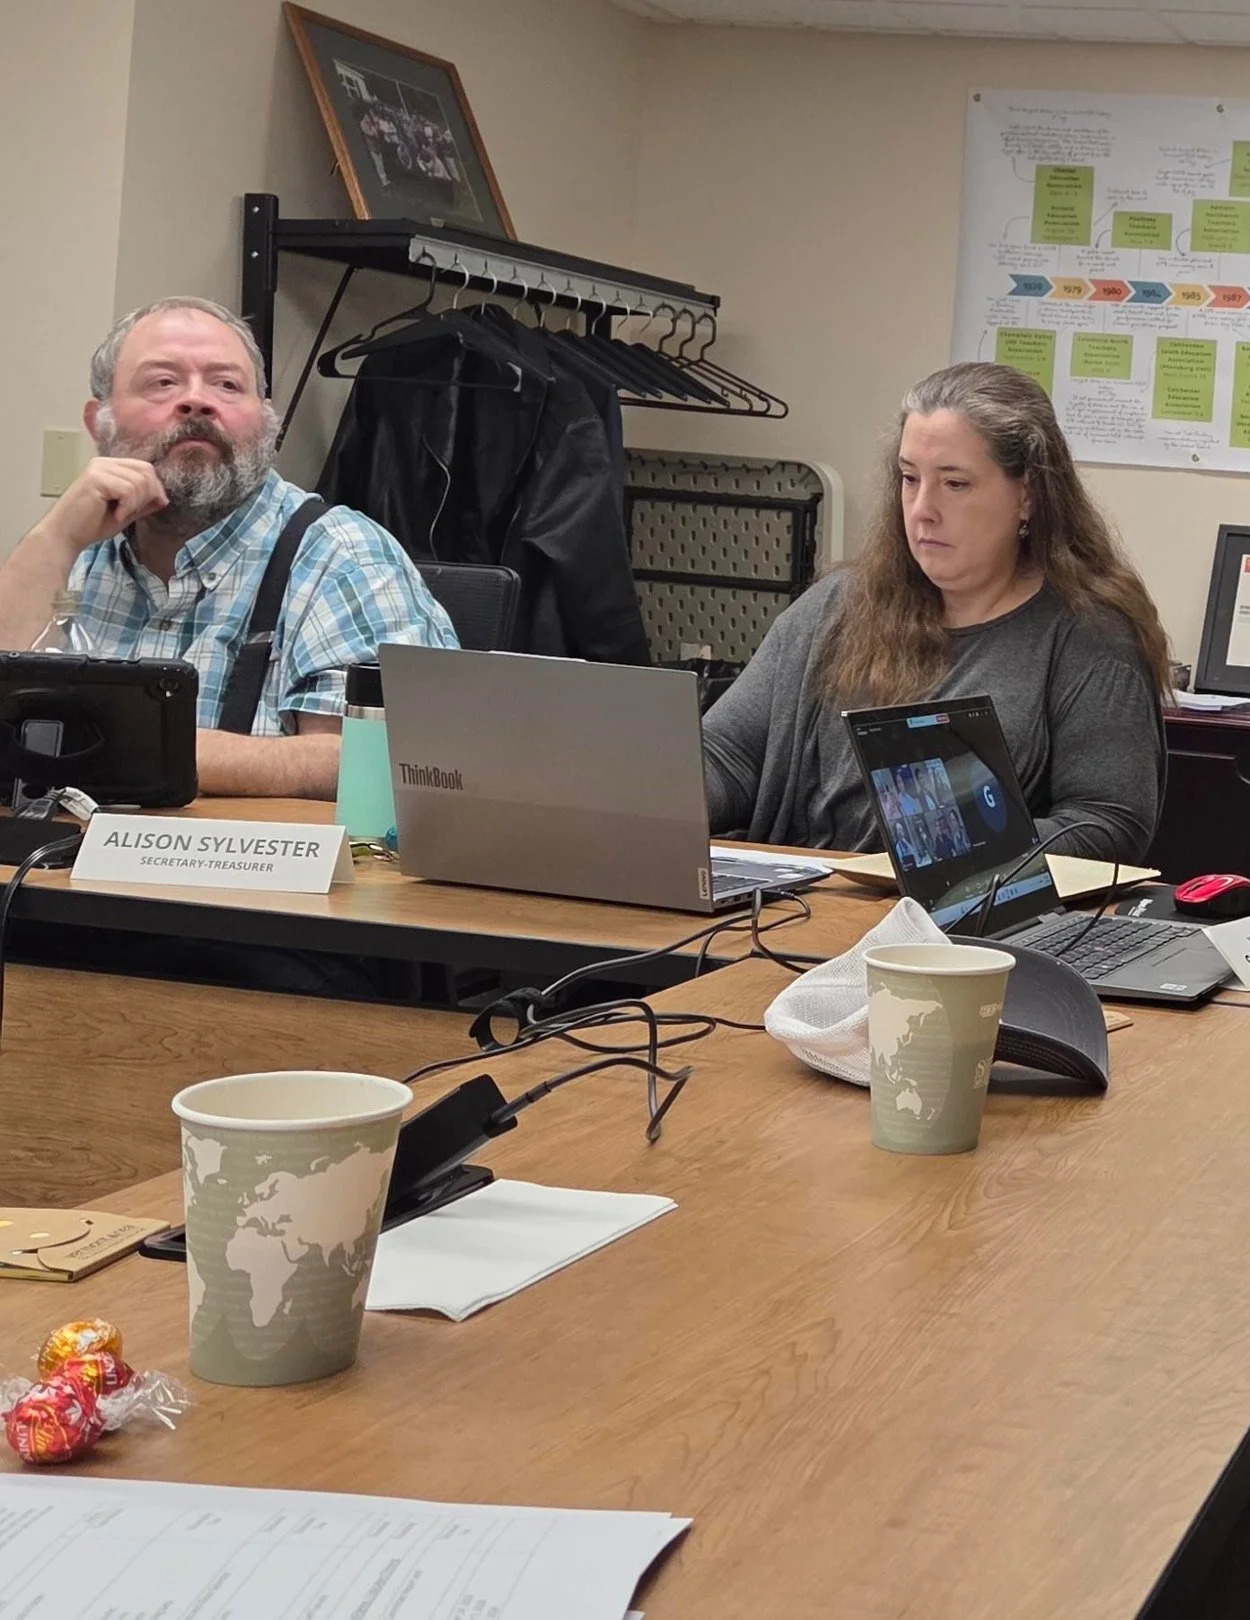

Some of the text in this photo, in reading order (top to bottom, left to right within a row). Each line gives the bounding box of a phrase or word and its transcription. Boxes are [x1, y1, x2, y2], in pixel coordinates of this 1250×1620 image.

[1063, 284, 1083, 295] 1979
[1102, 286, 1122, 297] 1980
[1181, 291, 1202, 301] 1985
[1222, 293, 1243, 303] 1987
[398, 762, 464, 791] ThinkBook
[982, 784, 997, 809] G
[103, 830, 321, 858] ALISON SYLVESTER
[139, 855, 275, 873] SECRETARY-TREASURER
